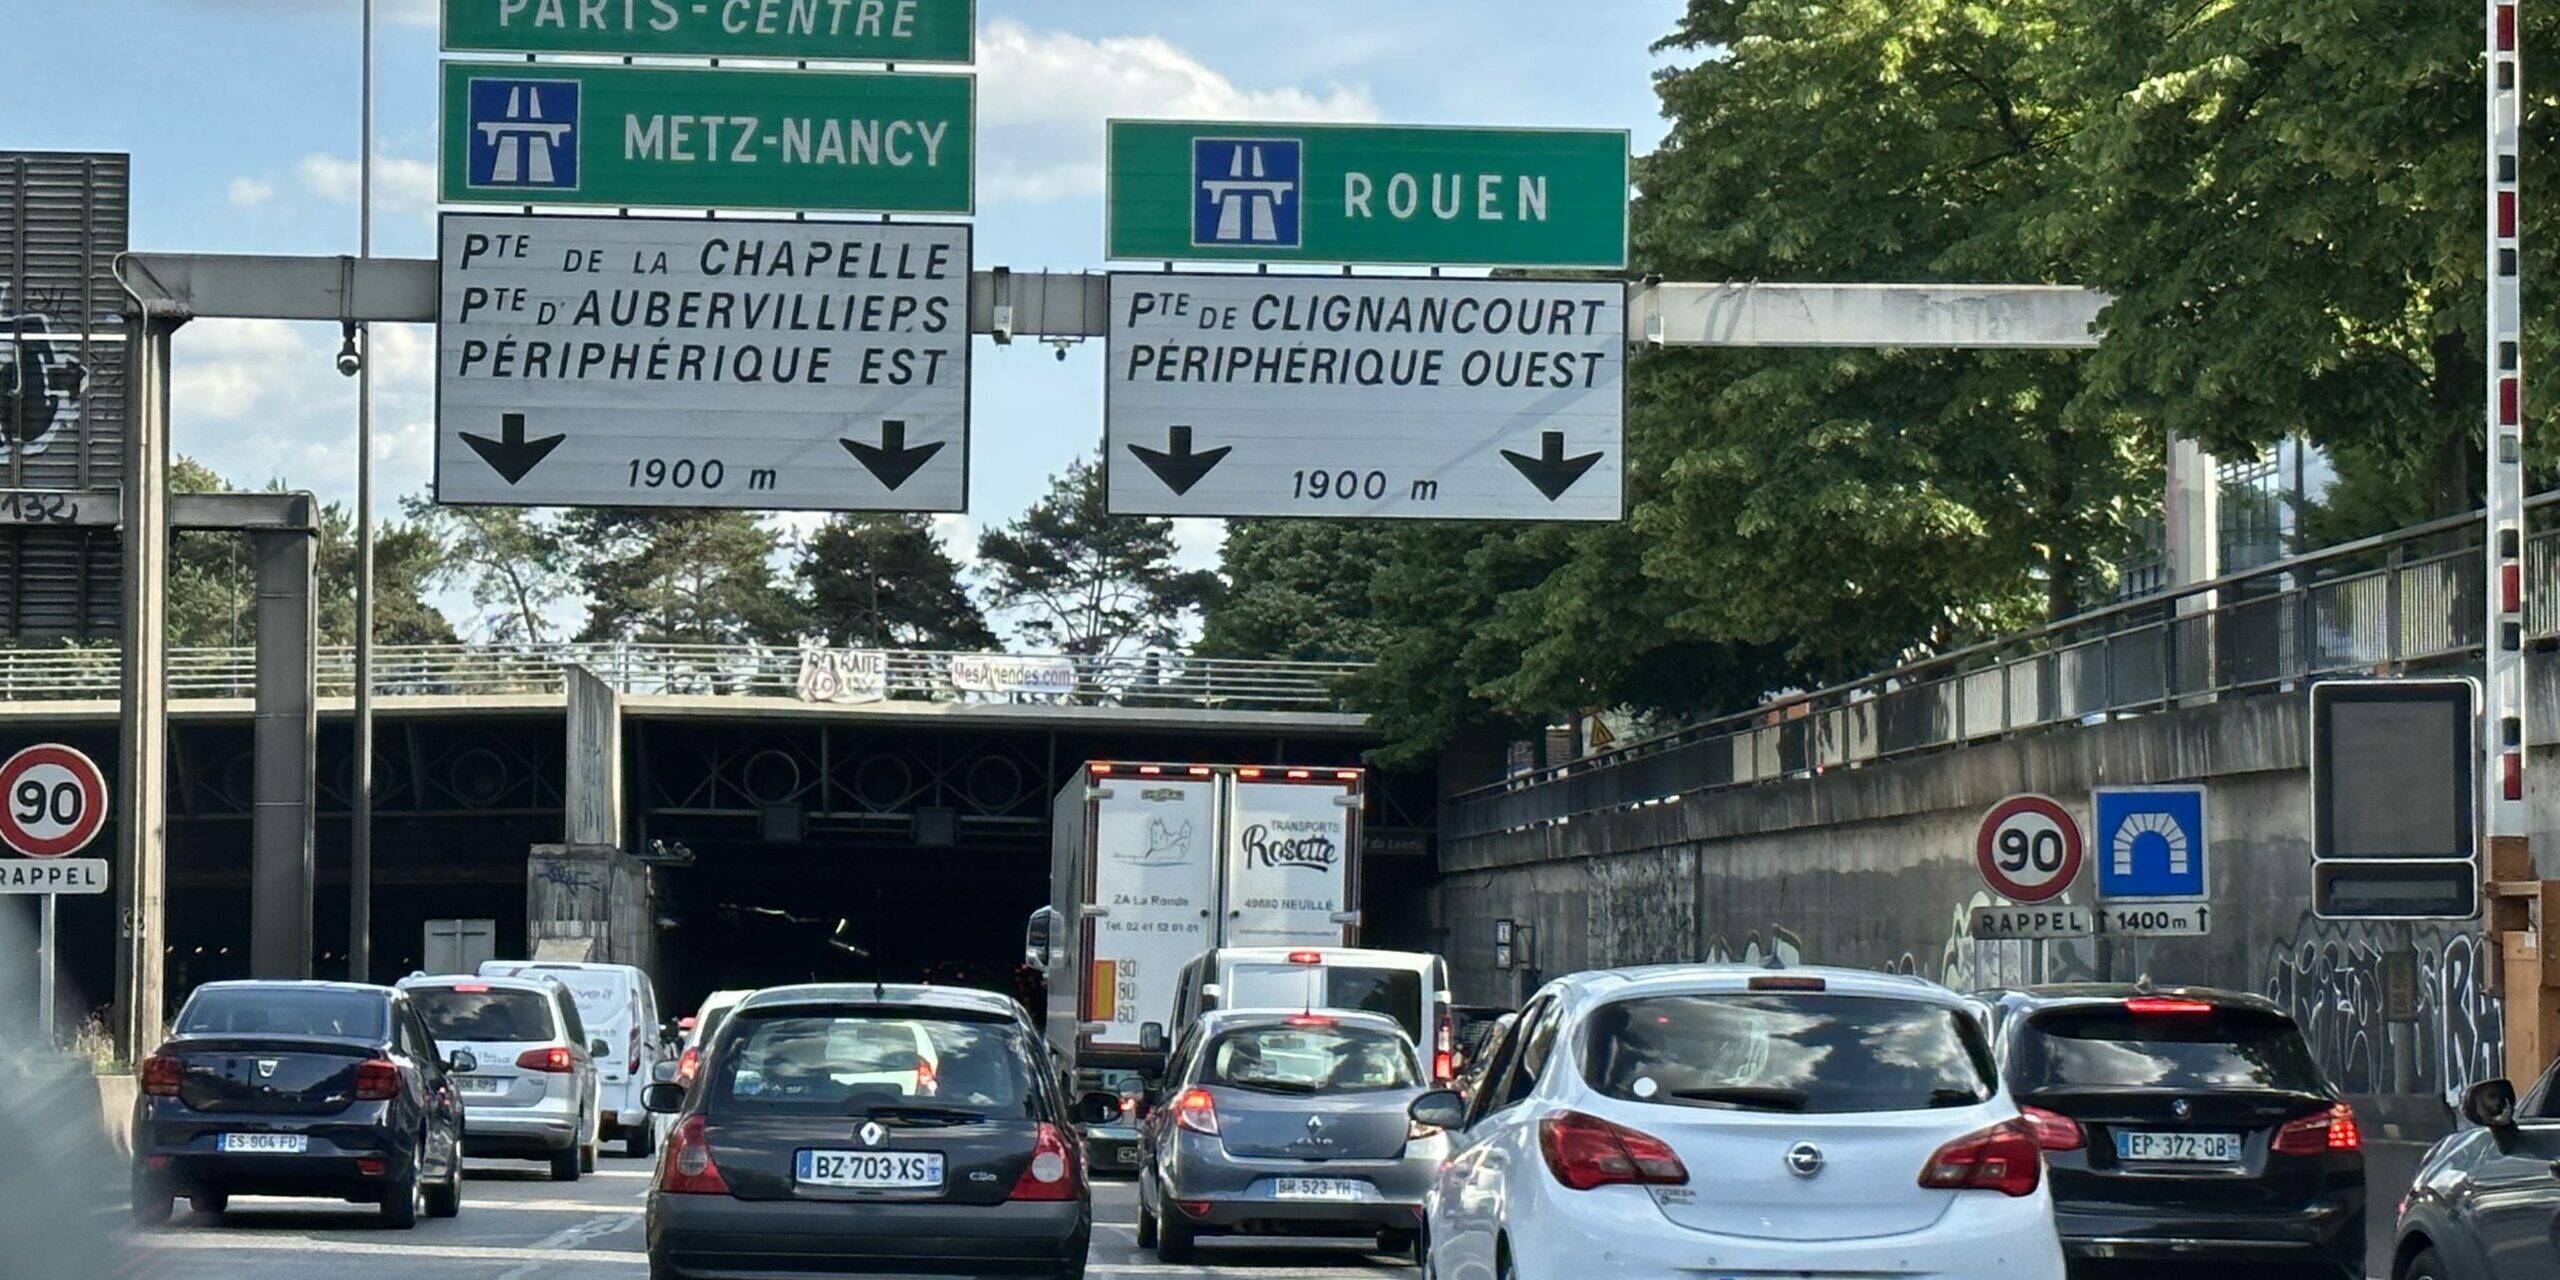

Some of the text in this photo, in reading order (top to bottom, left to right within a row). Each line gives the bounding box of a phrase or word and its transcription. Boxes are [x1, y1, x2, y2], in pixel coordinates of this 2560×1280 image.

[499, 0, 917, 37] PARIS-CENTRE
[624, 113, 948, 167] METZ-NANCY
[1344, 172, 1547, 221] ROUEN
[563, 249, 604, 274] DE
[633, 250, 669, 275] LA
[699, 238, 950, 280] CHAPELLE
[1199, 306, 1237, 330] DE
[1251, 293, 1605, 336] CLIGNANCOURT
[458, 334, 948, 386] PÉRIPHÉRIQUE EST
[1127, 338, 1605, 389] PÉRIPHÉRIQUE OUEST
[628, 458, 777, 490] 1900 m
[1292, 469, 1439, 501] 1900 m
[15, 779, 83, 826] 90
[1271, 819, 1341, 833] TRANSPORTS
[1242, 823, 1339, 872] Rosette
[1998, 828, 2064, 873] 90
[1113, 894, 1130, 904] ZA
[1981, 911, 2082, 933] RAPPEL
[816, 1155, 926, 1180] BZ-703-XS
